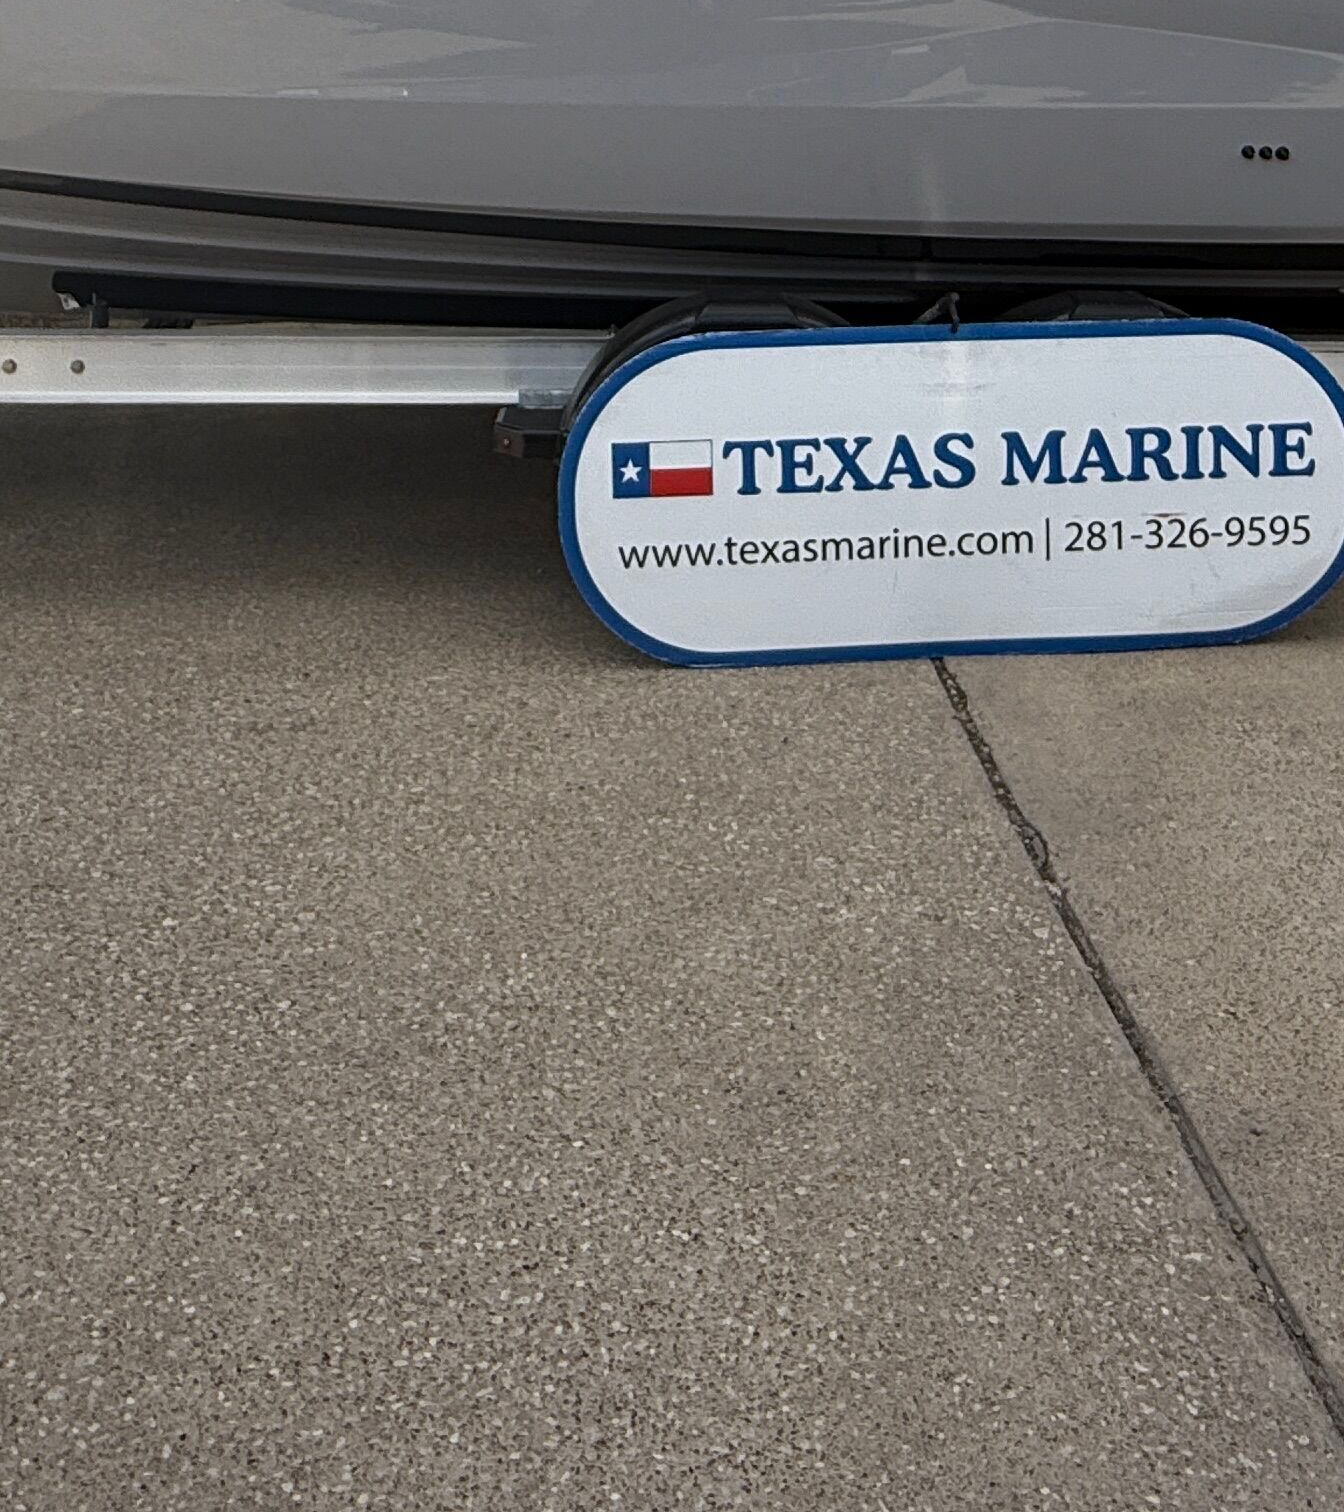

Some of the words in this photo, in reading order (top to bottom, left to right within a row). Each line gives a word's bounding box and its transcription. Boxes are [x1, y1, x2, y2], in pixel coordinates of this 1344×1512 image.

[721, 429, 978, 497] TEXAS
[1001, 421, 1318, 488] MARINE
[617, 526, 1035, 570] www.texasmarine.com
[1063, 513, 1314, 554] 281-326-9595
